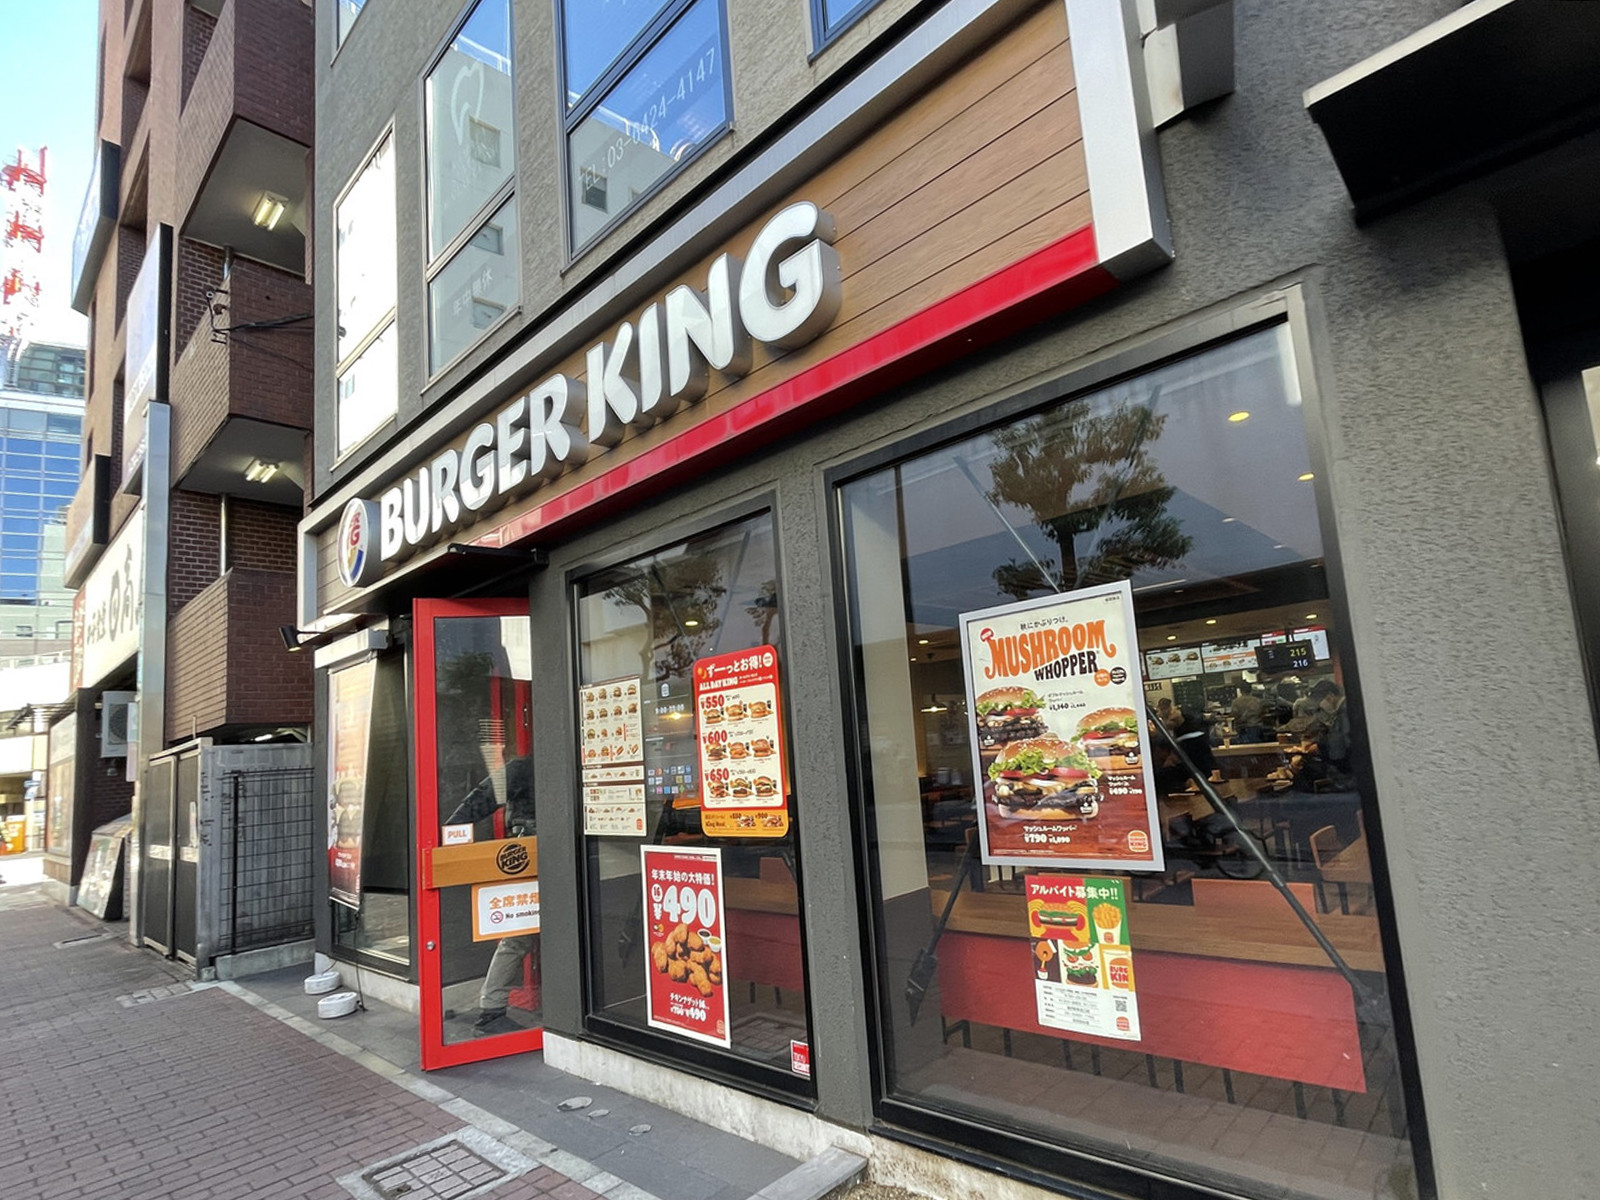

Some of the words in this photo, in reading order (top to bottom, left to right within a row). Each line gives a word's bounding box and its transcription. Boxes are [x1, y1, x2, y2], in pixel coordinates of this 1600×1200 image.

[381, 373, 572, 562] BURGER
[586, 200, 827, 444] KING
[984, 619, 1117, 680] MUSHROOM
[1290, 648, 1307, 658] 215
[1034, 651, 1099, 682] WHOPPER
[703, 730, 728, 744] ¥600
[705, 768, 730, 781] ¥650
[448, 830, 467, 839] PULL
[1024, 834, 1047, 843] ¥790
[500, 846, 527, 860] BURGER
[501, 851, 528, 869] KING
[1031, 884, 1118, 900] アルバイト募集中!!
